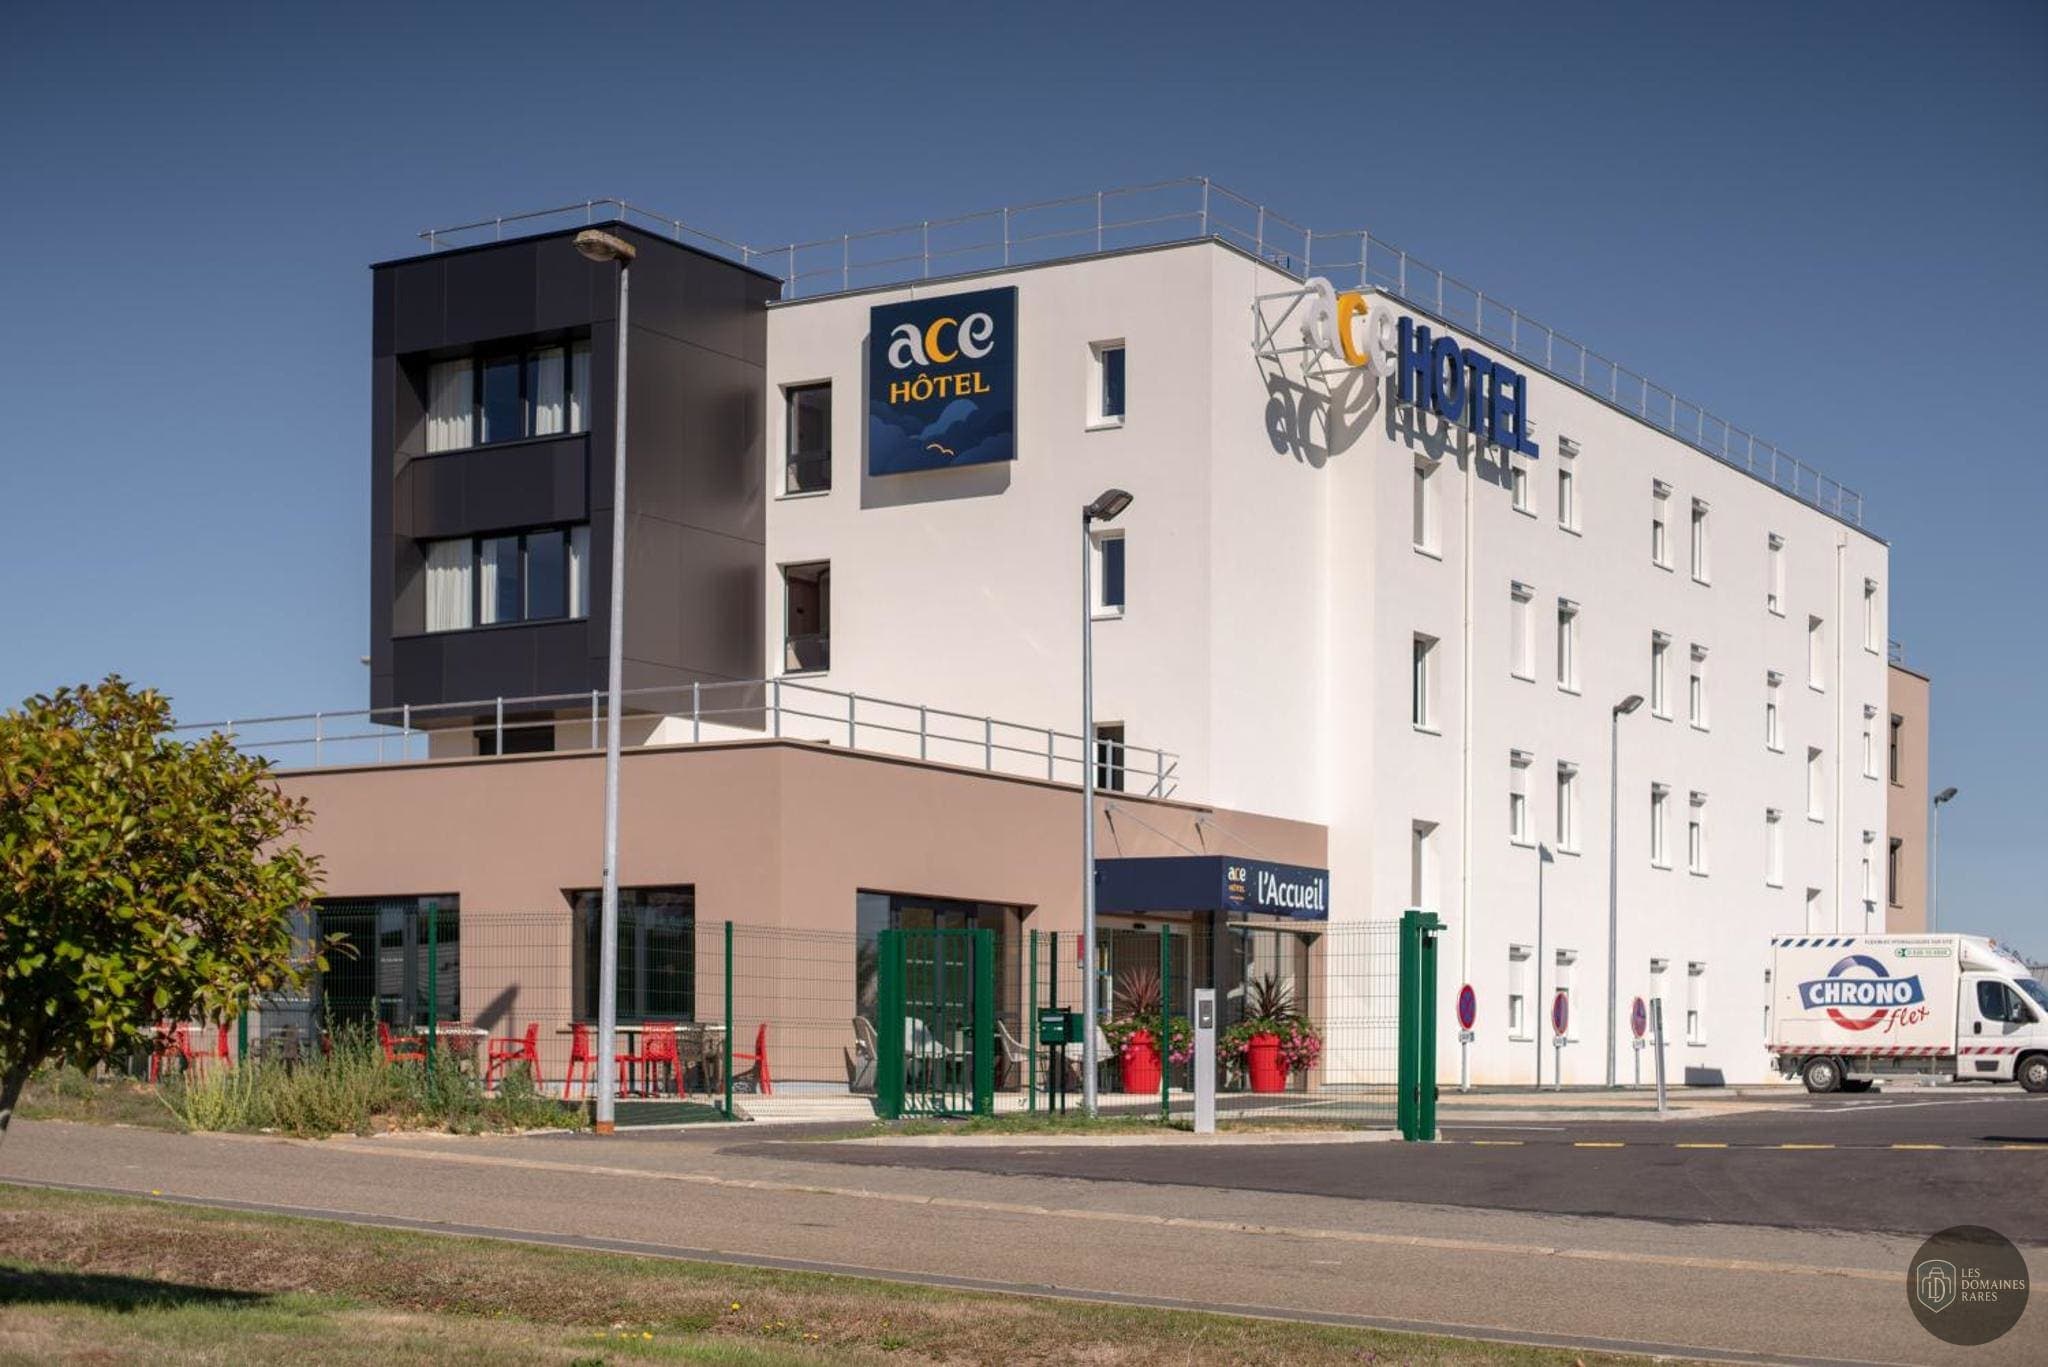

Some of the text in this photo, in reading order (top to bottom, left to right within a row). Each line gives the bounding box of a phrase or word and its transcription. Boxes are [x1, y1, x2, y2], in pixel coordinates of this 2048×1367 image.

[888, 312, 995, 369] ace
[890, 372, 990, 404] HÔTEL
[1258, 871, 1325, 911] l'Accueil
[1808, 981, 1913, 1004] CHRONO
[1883, 1006, 1930, 1033] flex
